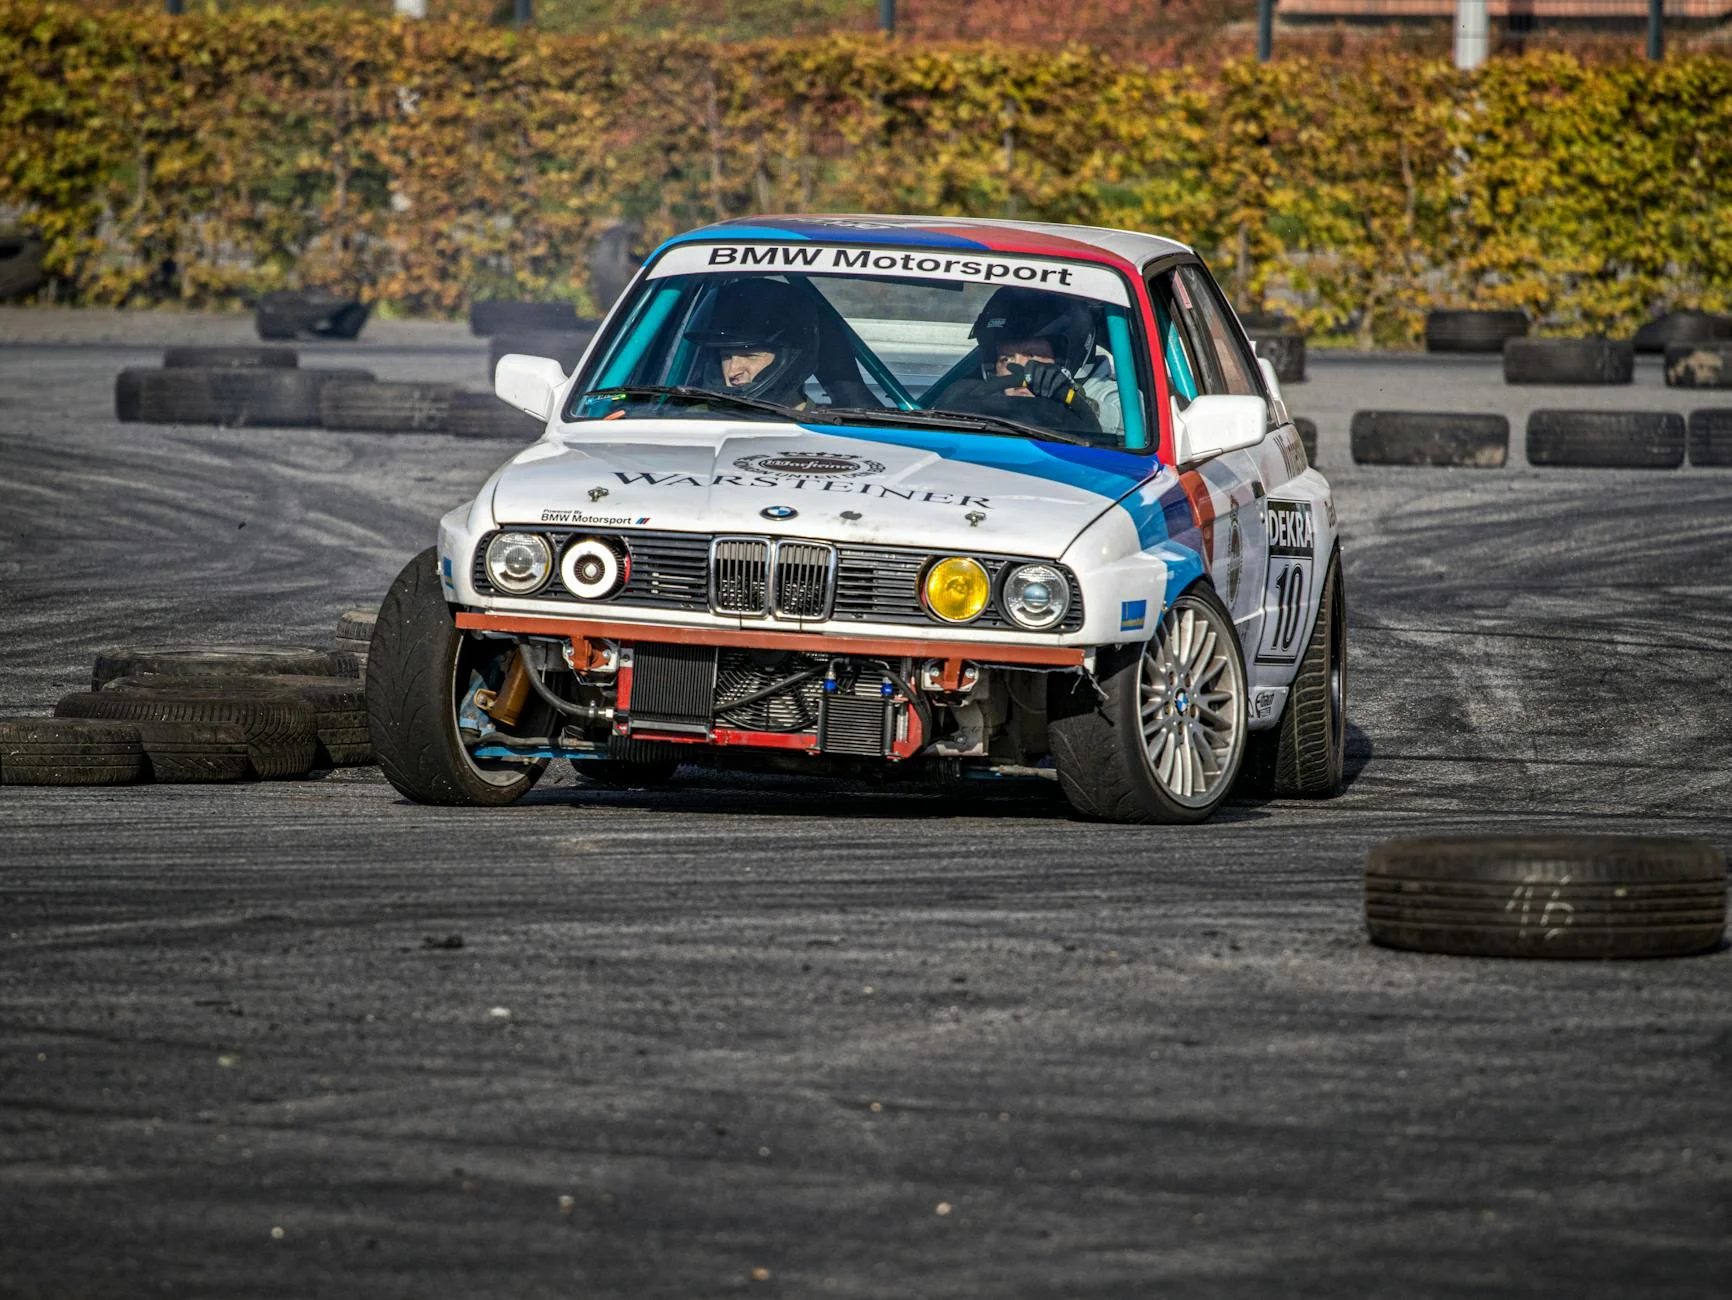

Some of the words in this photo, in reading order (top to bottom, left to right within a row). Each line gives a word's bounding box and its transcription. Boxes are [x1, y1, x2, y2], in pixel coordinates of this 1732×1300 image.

[708, 246, 823, 266] BMW
[832, 249, 1073, 287] Motorsport
[611, 471, 992, 509] WARSTEINER
[541, 513, 570, 522] BMW
[572, 514, 631, 525] Motorsport
[1269, 509, 1314, 549] DEKRA
[1271, 562, 1304, 652] 10
